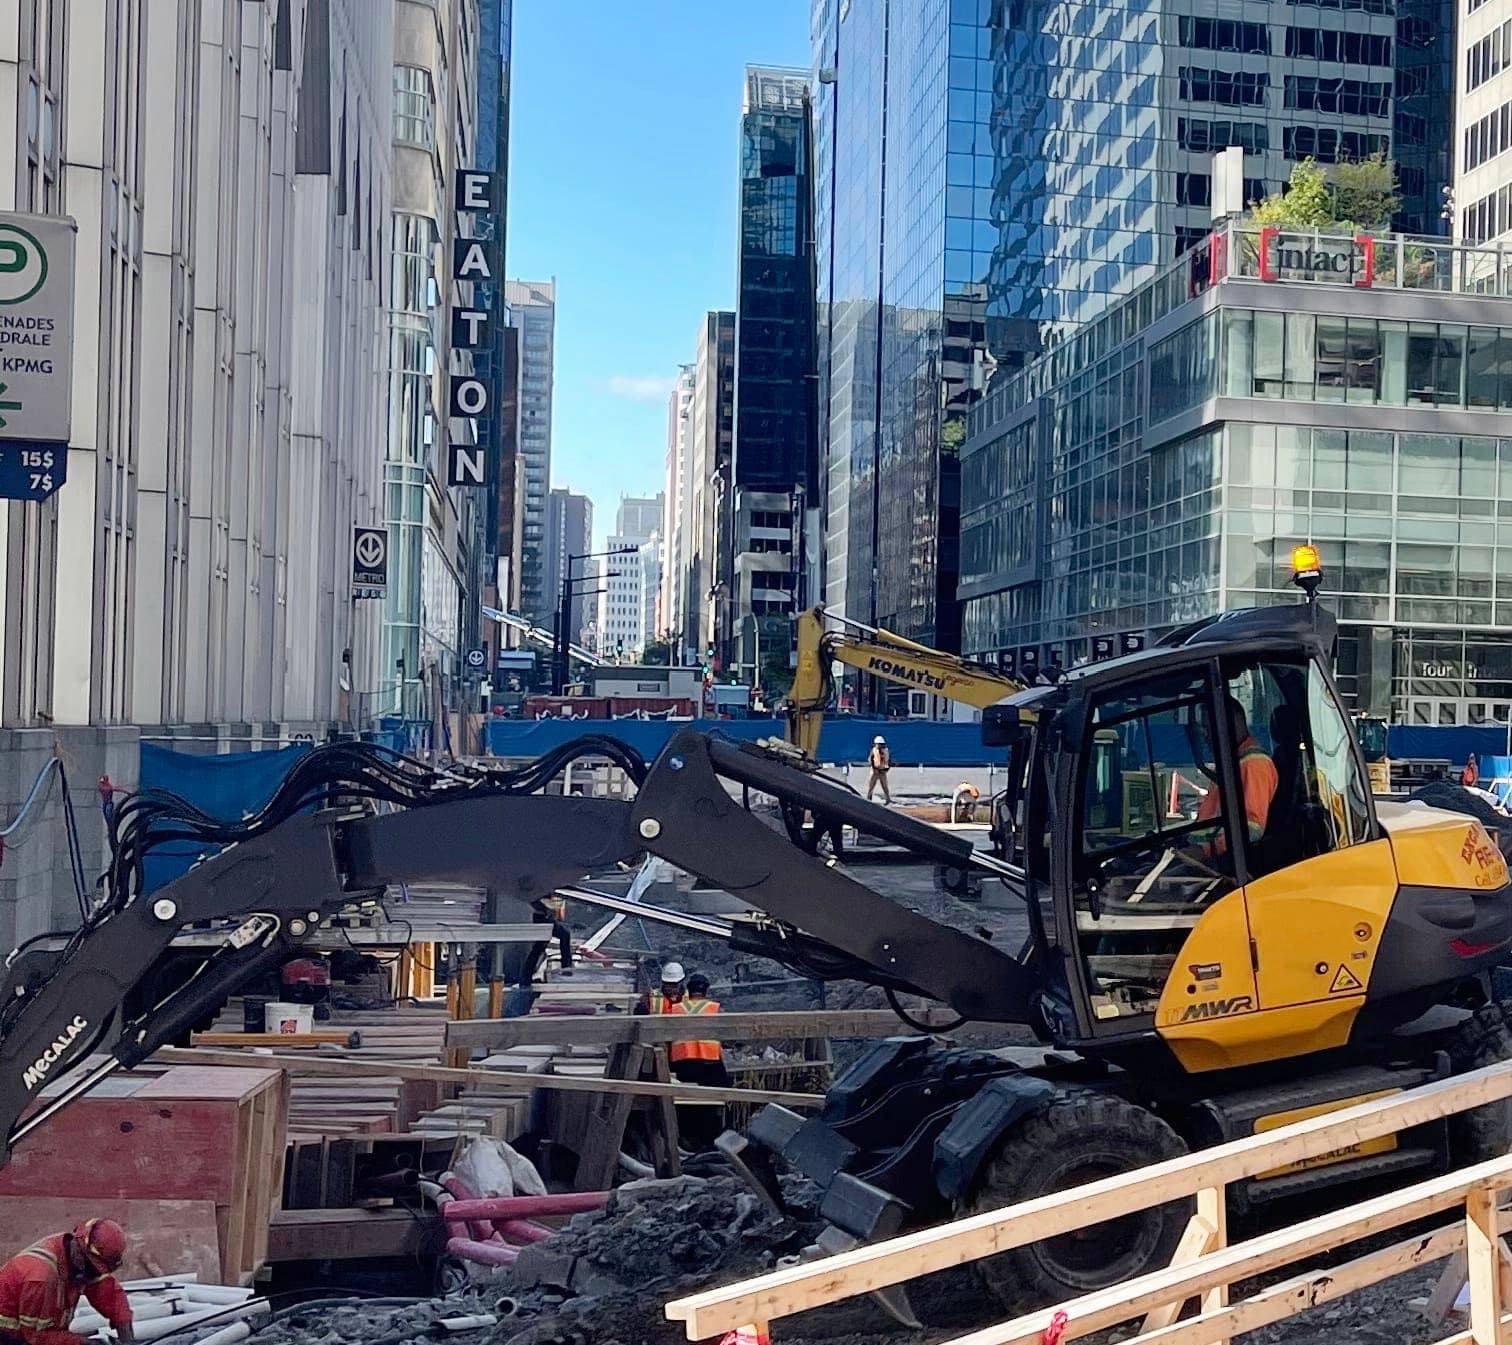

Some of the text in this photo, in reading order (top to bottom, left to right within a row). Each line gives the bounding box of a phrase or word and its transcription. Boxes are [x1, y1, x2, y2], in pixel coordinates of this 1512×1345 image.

[455, 173, 491, 484] EATON
[0, 332, 51, 347] DRALE
[3, 357, 53, 374] KPMG
[21, 450, 54, 468] 15$
[29, 473, 53, 492] 7$
[868, 656, 945, 690] KOMATSU
[1422, 662, 1454, 677] Tour
